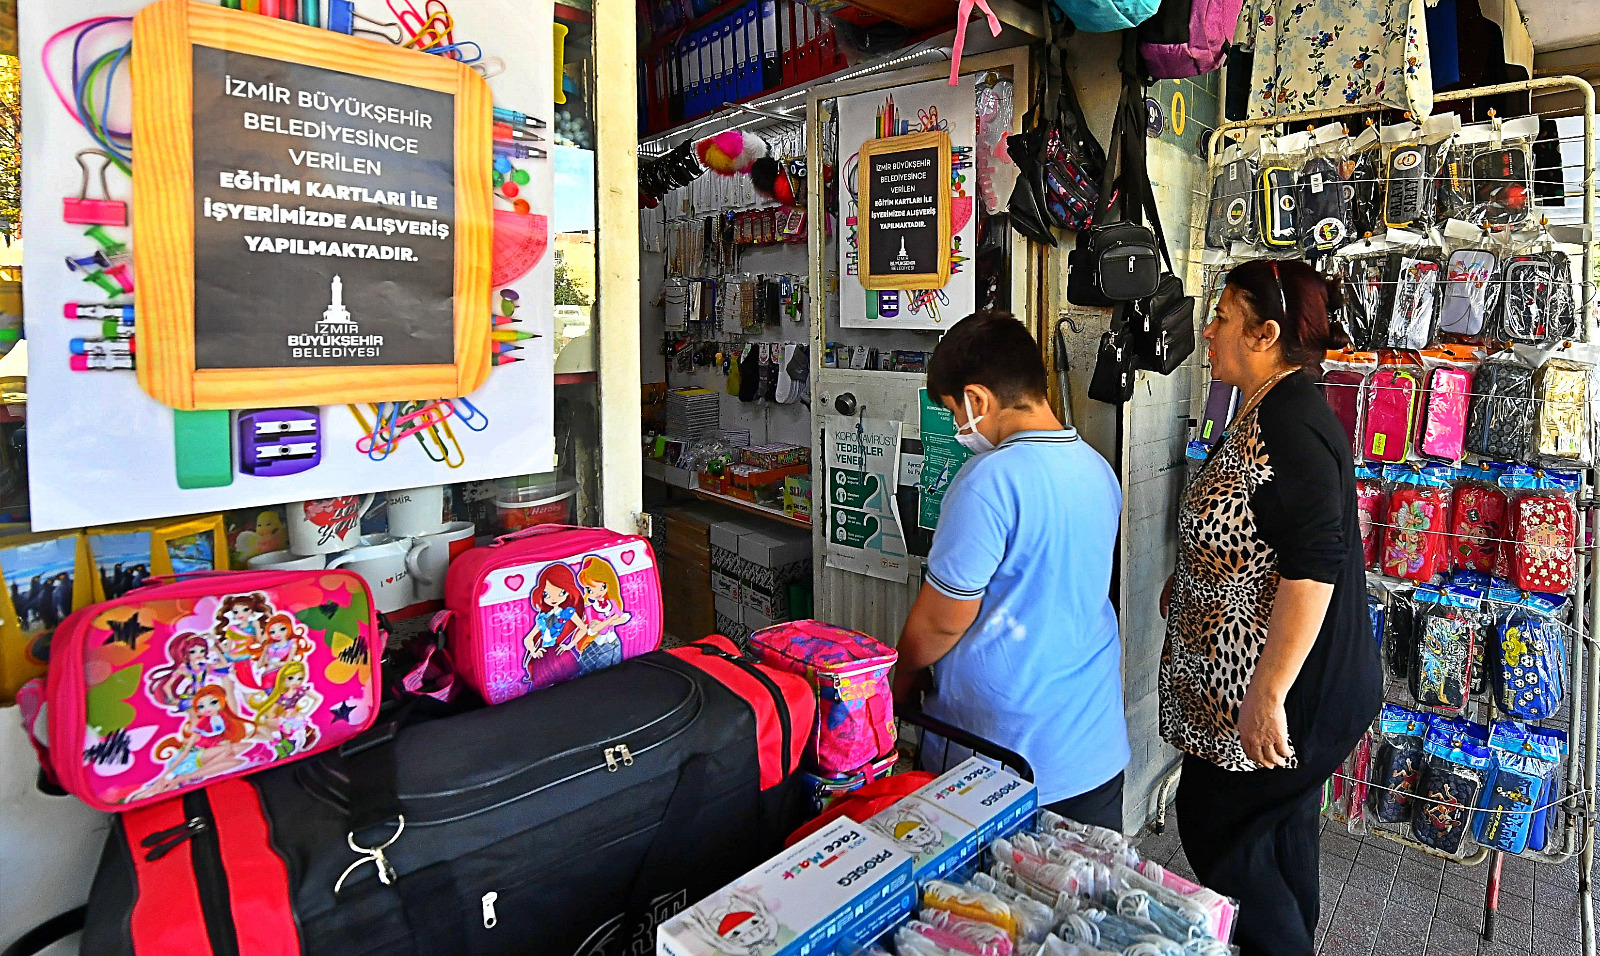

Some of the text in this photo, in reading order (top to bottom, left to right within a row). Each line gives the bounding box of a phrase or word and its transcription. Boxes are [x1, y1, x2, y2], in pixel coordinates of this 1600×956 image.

[225, 75, 432, 129] İZMİR BÜYÜKŞEHİR
[244, 112, 419, 154] BELEDİYESİNCE
[288, 149, 381, 176] VERİLEN
[219, 170, 438, 210] EĞİTİM KARTLARI İLE
[203, 197, 450, 240] İŞYERİMİZDE ALIŞVERİŞ
[244, 236, 419, 262] YAPILMAKTADIR.
[287, 333, 384, 347] BÜYÜKŞEHİR
[314, 323, 359, 334] İZMİR
[292, 346, 380, 358] BELEDİYESİ
[823, 829, 861, 854] Face
[781, 850, 824, 881] Mask
[836, 848, 893, 887] PROSEG
